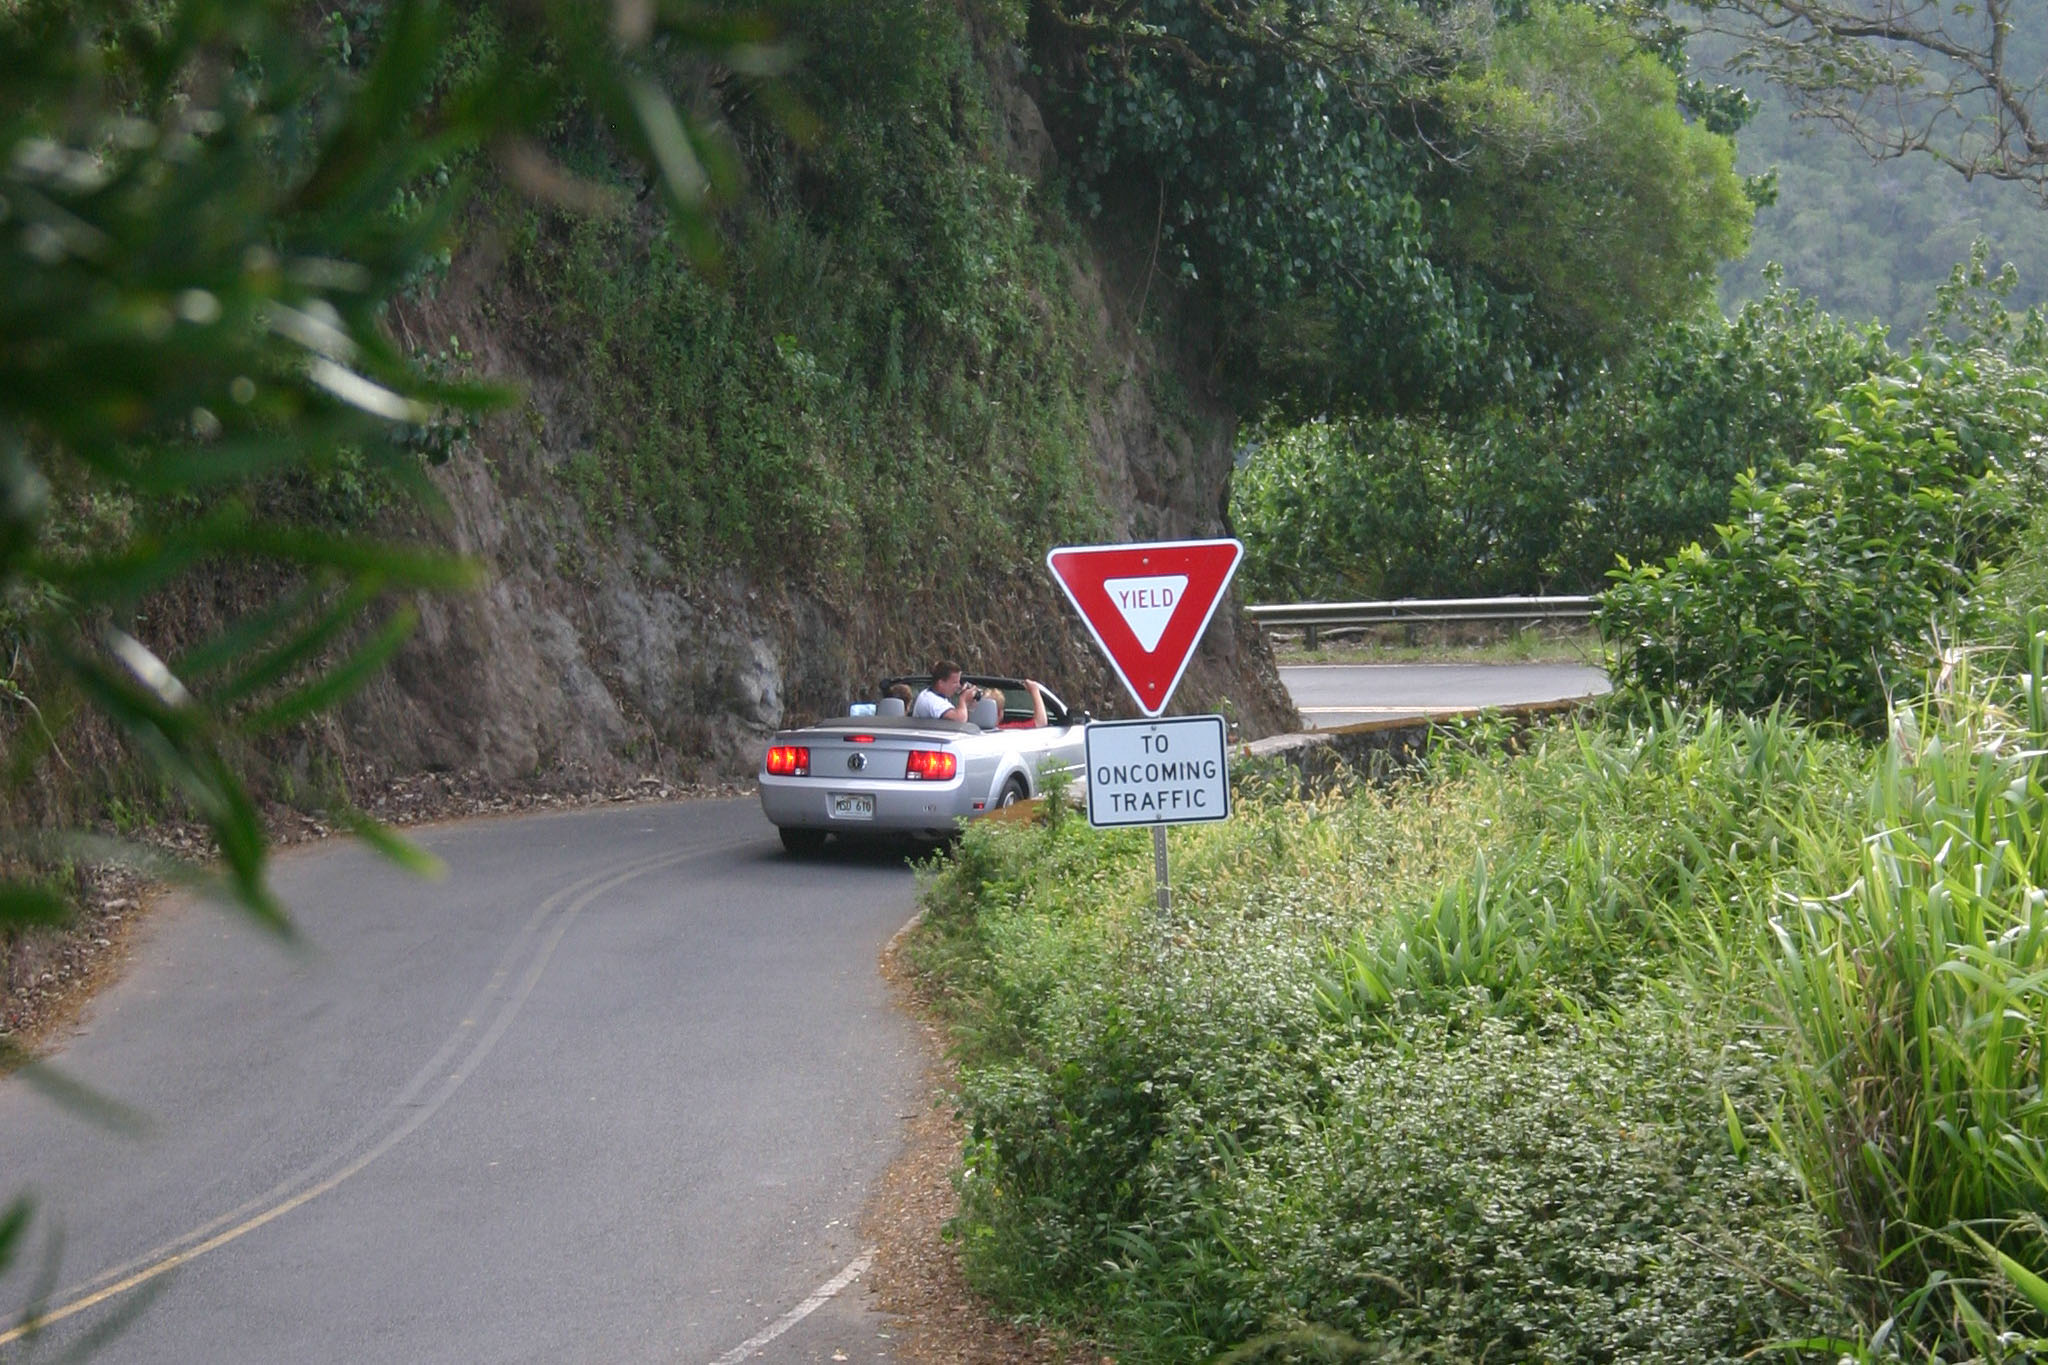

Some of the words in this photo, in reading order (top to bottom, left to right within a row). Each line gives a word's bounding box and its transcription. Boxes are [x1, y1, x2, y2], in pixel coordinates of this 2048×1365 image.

[1119, 588, 1174, 609] YIELD
[1141, 734, 1169, 754] TO
[1097, 760, 1216, 785] ONCOMING
[1110, 789, 1206, 812] TRAFFIC
